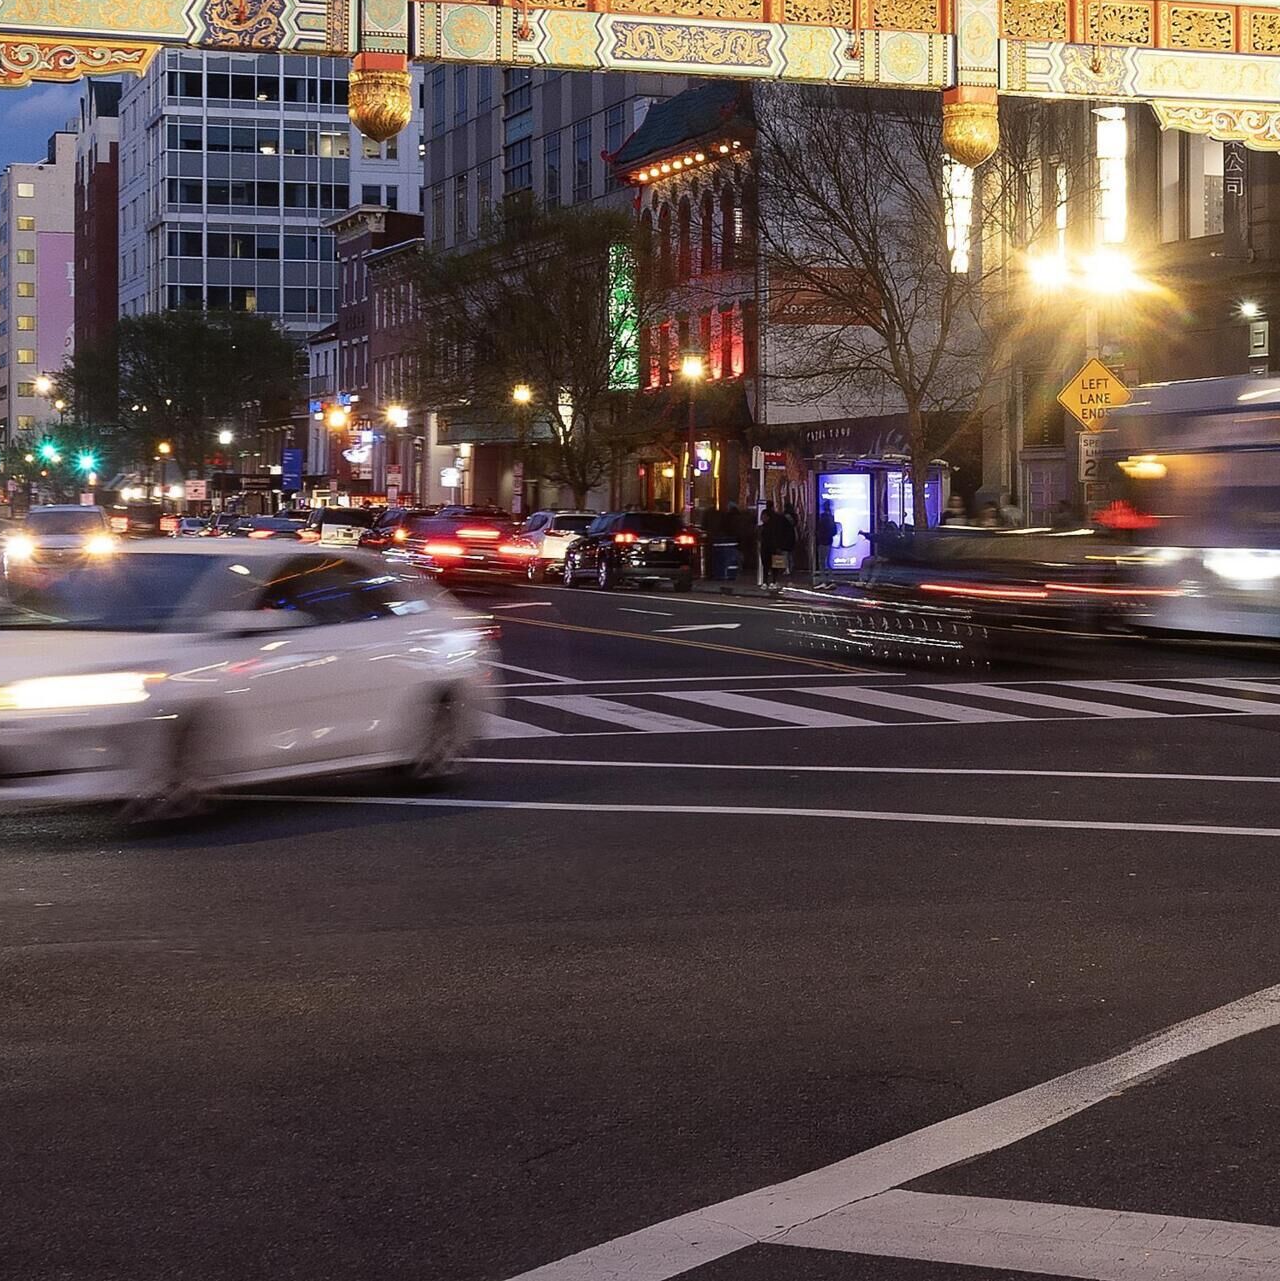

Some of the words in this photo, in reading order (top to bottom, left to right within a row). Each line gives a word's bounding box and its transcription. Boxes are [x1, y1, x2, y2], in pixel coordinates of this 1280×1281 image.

[1081, 378, 1109, 390] LEFT
[1080, 392, 1111, 405] LANE
[1081, 408, 1111, 420] ENDS
